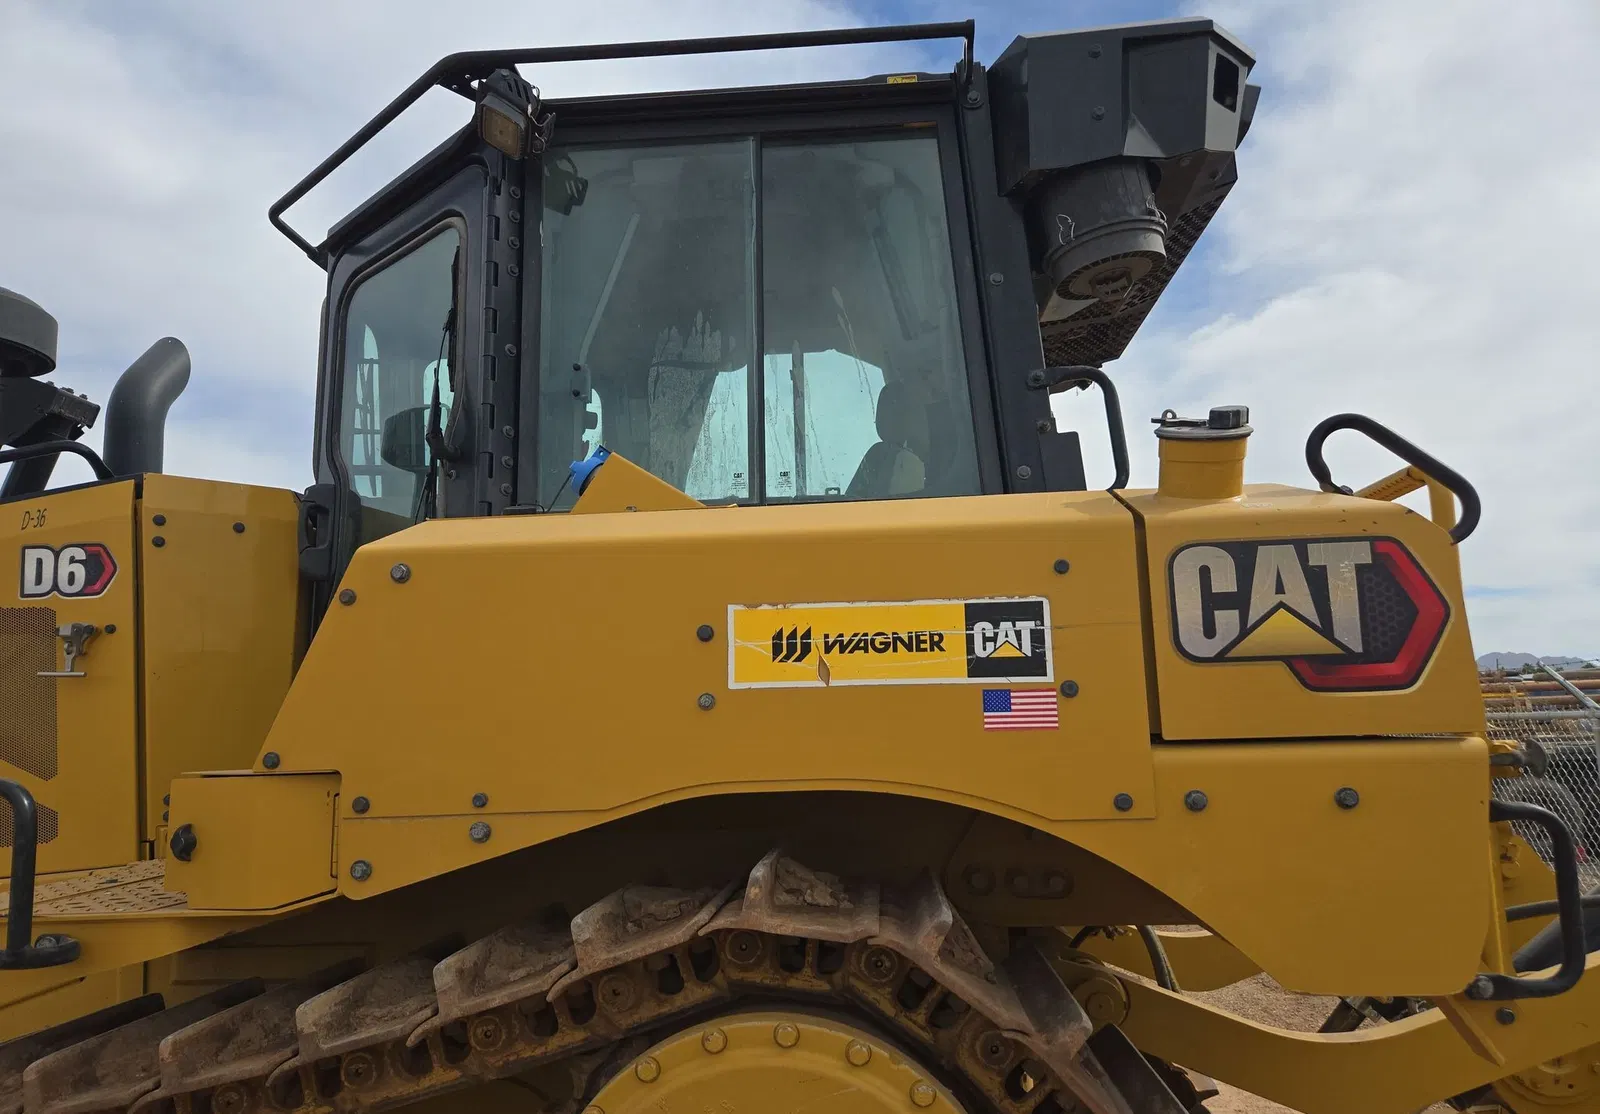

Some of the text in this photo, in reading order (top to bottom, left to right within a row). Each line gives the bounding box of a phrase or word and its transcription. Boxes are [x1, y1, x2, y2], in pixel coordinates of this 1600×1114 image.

[21, 508, 47, 530] D-36
[24, 547, 87, 595] D6
[1173, 541, 1373, 658] CAT
[823, 630, 947, 655] WAGNER
